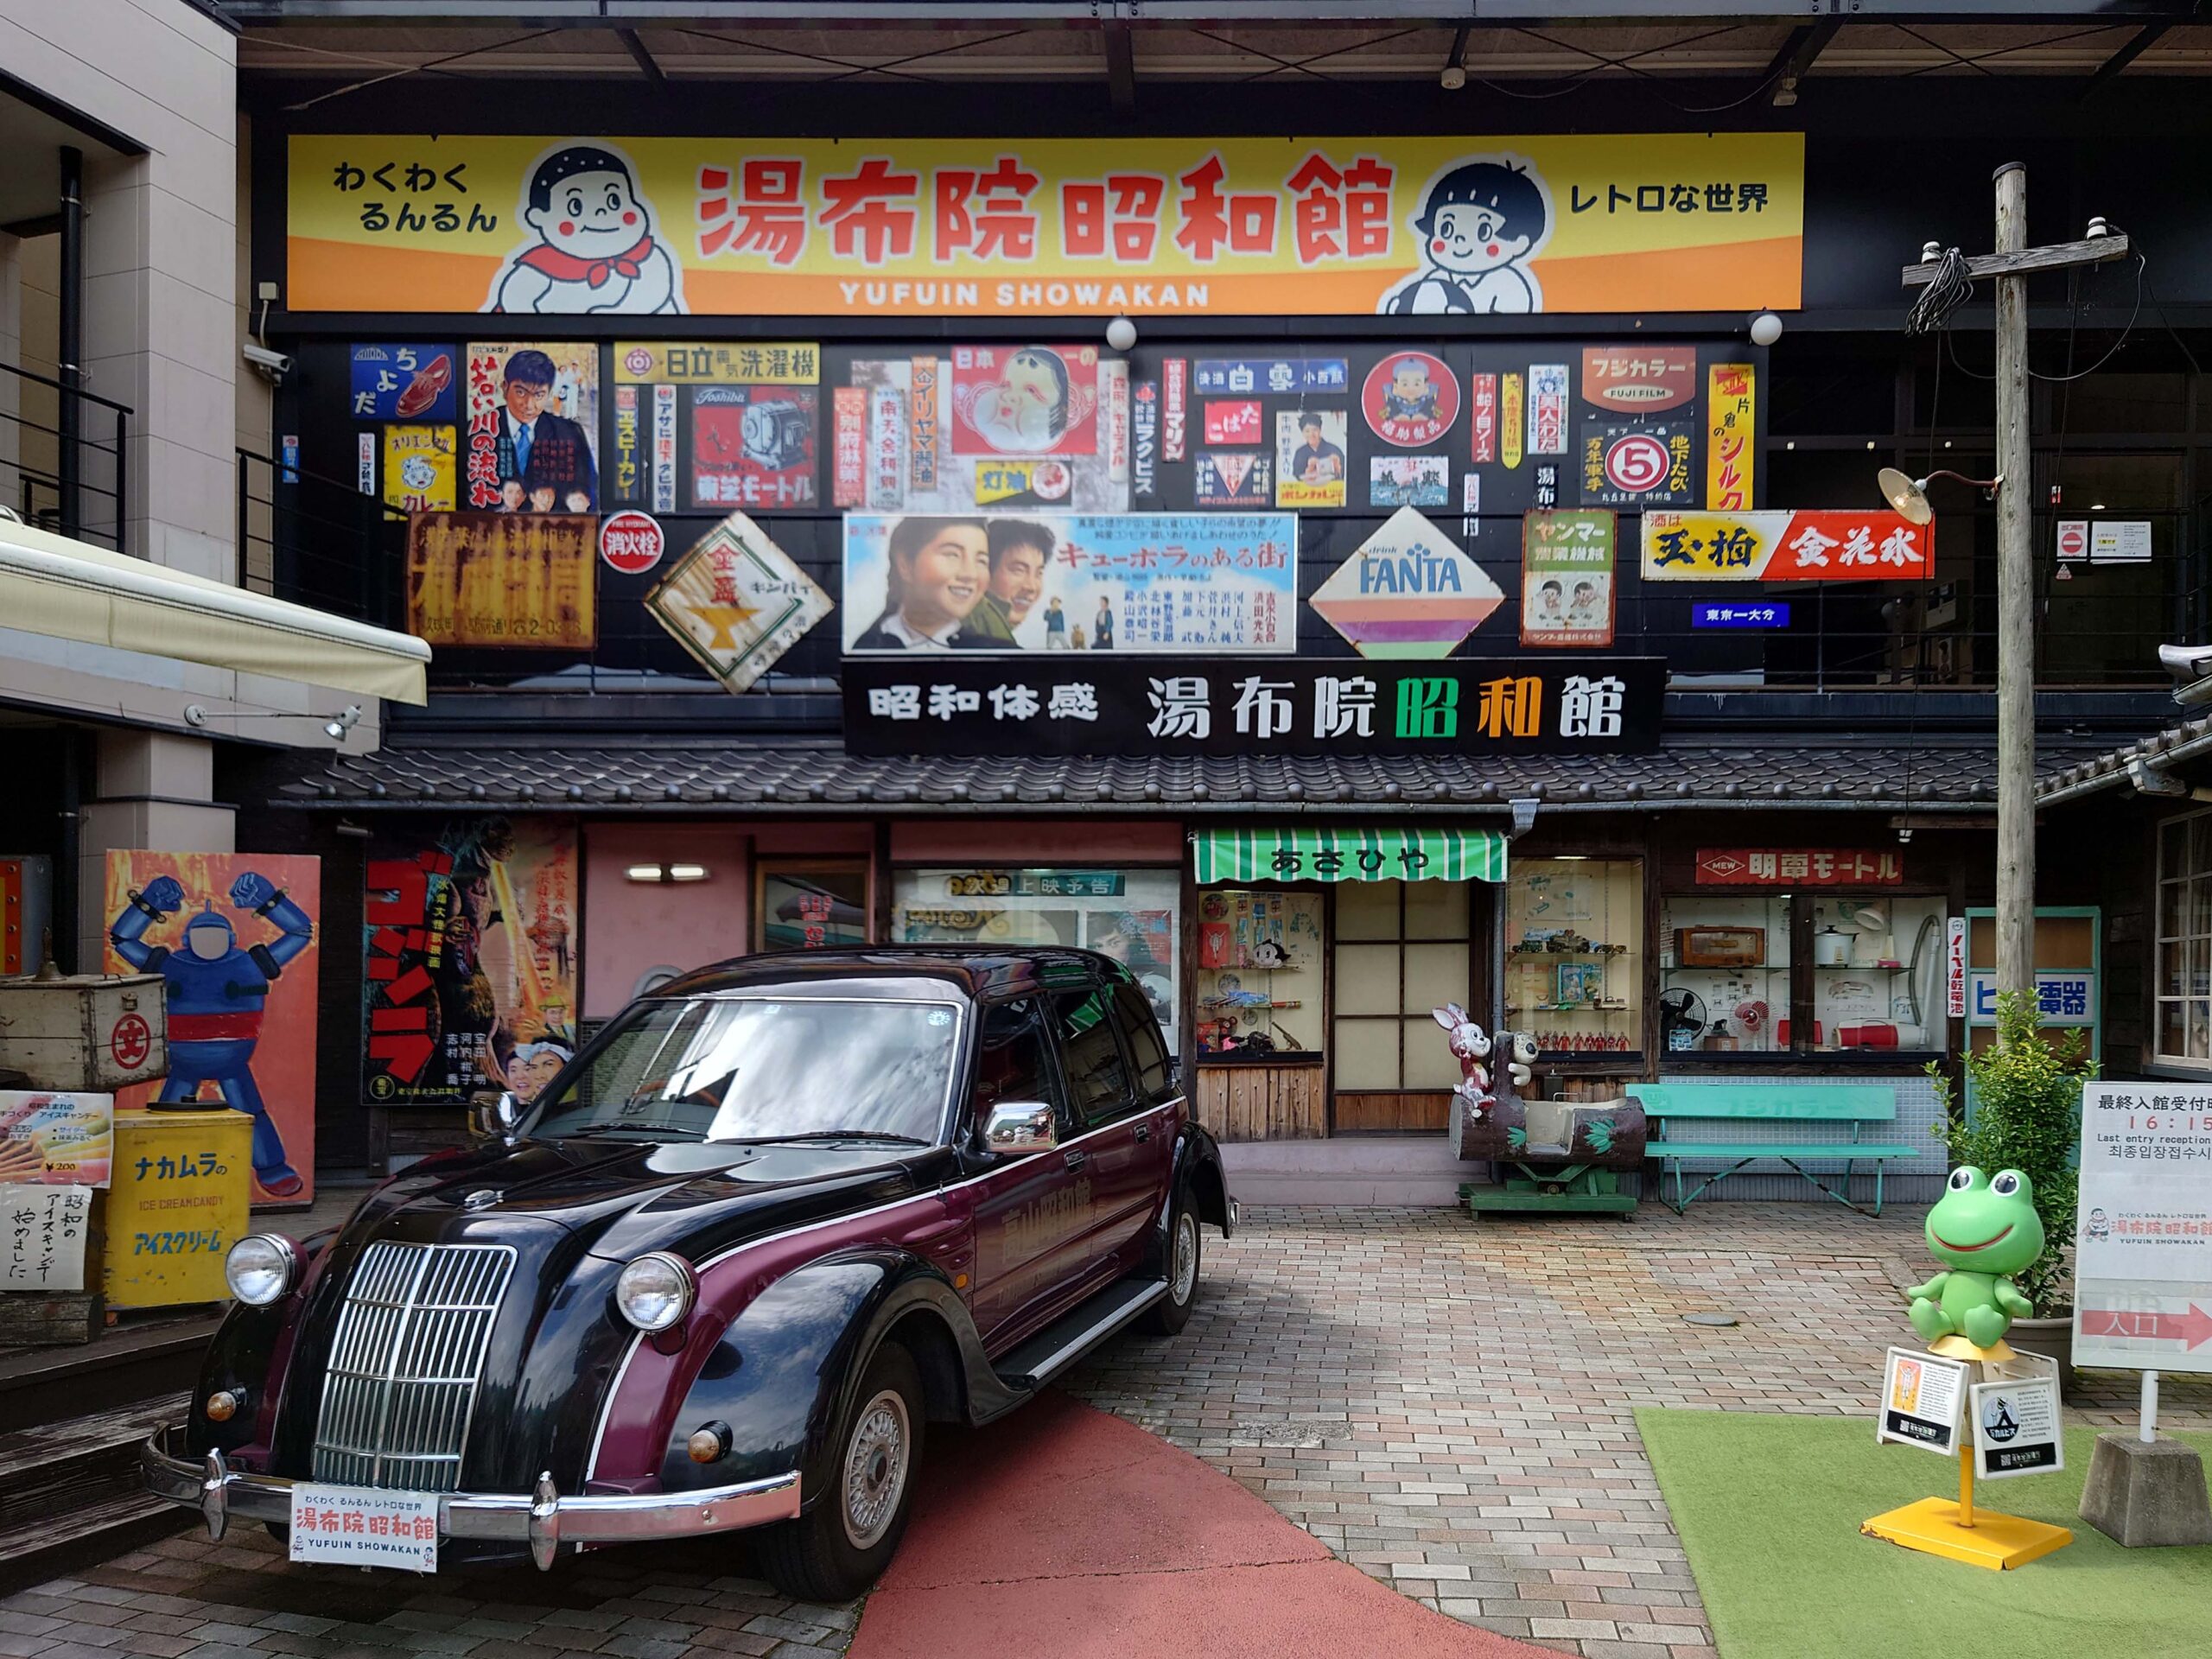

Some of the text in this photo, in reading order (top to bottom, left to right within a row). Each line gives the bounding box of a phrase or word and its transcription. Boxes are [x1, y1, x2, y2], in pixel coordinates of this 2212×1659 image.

[333, 162, 468, 194] わくわく
[698, 152, 1395, 264] 湯布院昭和館
[1571, 182, 1769, 214] レトロな世界
[359, 202, 498, 232] るんるん
[840, 283, 1209, 307] YUFUIN SHOWAKAN
[956, 350, 995, 369] 日本
[1592, 358, 1686, 378] フジカラー
[354, 347, 417, 414] ちよだ
[1611, 388, 1666, 397] FUJI FILM
[695, 388, 746, 404] Toshiba
[617, 410, 636, 499] エスビーカレー
[1584, 436, 1605, 493] 万年軍手
[1622, 447, 1654, 480] 5
[1669, 435, 1691, 493] 地下たび
[982, 470, 1027, 492] 灯油
[1717, 436, 1745, 511] シルク
[1536, 466, 1555, 510] 湯布
[1535, 522, 1606, 543] ヤンマー
[1649, 513, 1682, 528] 酒は
[606, 529, 658, 556] 消火栓
[1369, 545, 1398, 556] drink
[1359, 552, 1462, 594] FANTA
[868, 683, 1099, 721] 昭和体感
[1146, 674, 1624, 740] 湯布院昭和館
[1270, 847, 1430, 874] あさひや
[1712, 861, 1737, 870] MEW
[1748, 853, 1900, 880] 明電モートル
[966, 878, 1110, 895] 次週上映予告
[1950, 934, 1964, 1014] ノーベル乾電池
[2097, 1133, 2211, 1146] Last entry reception
[2108, 1145, 2211, 1160] 최종입장접수시
[135, 1152, 228, 1181] ナカムラの
[60, 1193, 84, 1239] 昭和の
[138, 1199, 156, 1211] ICE
[9, 1206, 36, 1279] 始めました
[134, 1230, 222, 1256] アイスクリーム
[2102, 1312, 2158, 1336] 入口
[305, 1495, 423, 1511] わくわく るんるん レトロな世界
[296, 1506, 435, 1541] 湯布院昭和館
[308, 1538, 421, 1555] YUFUIN SHOWAKAN
